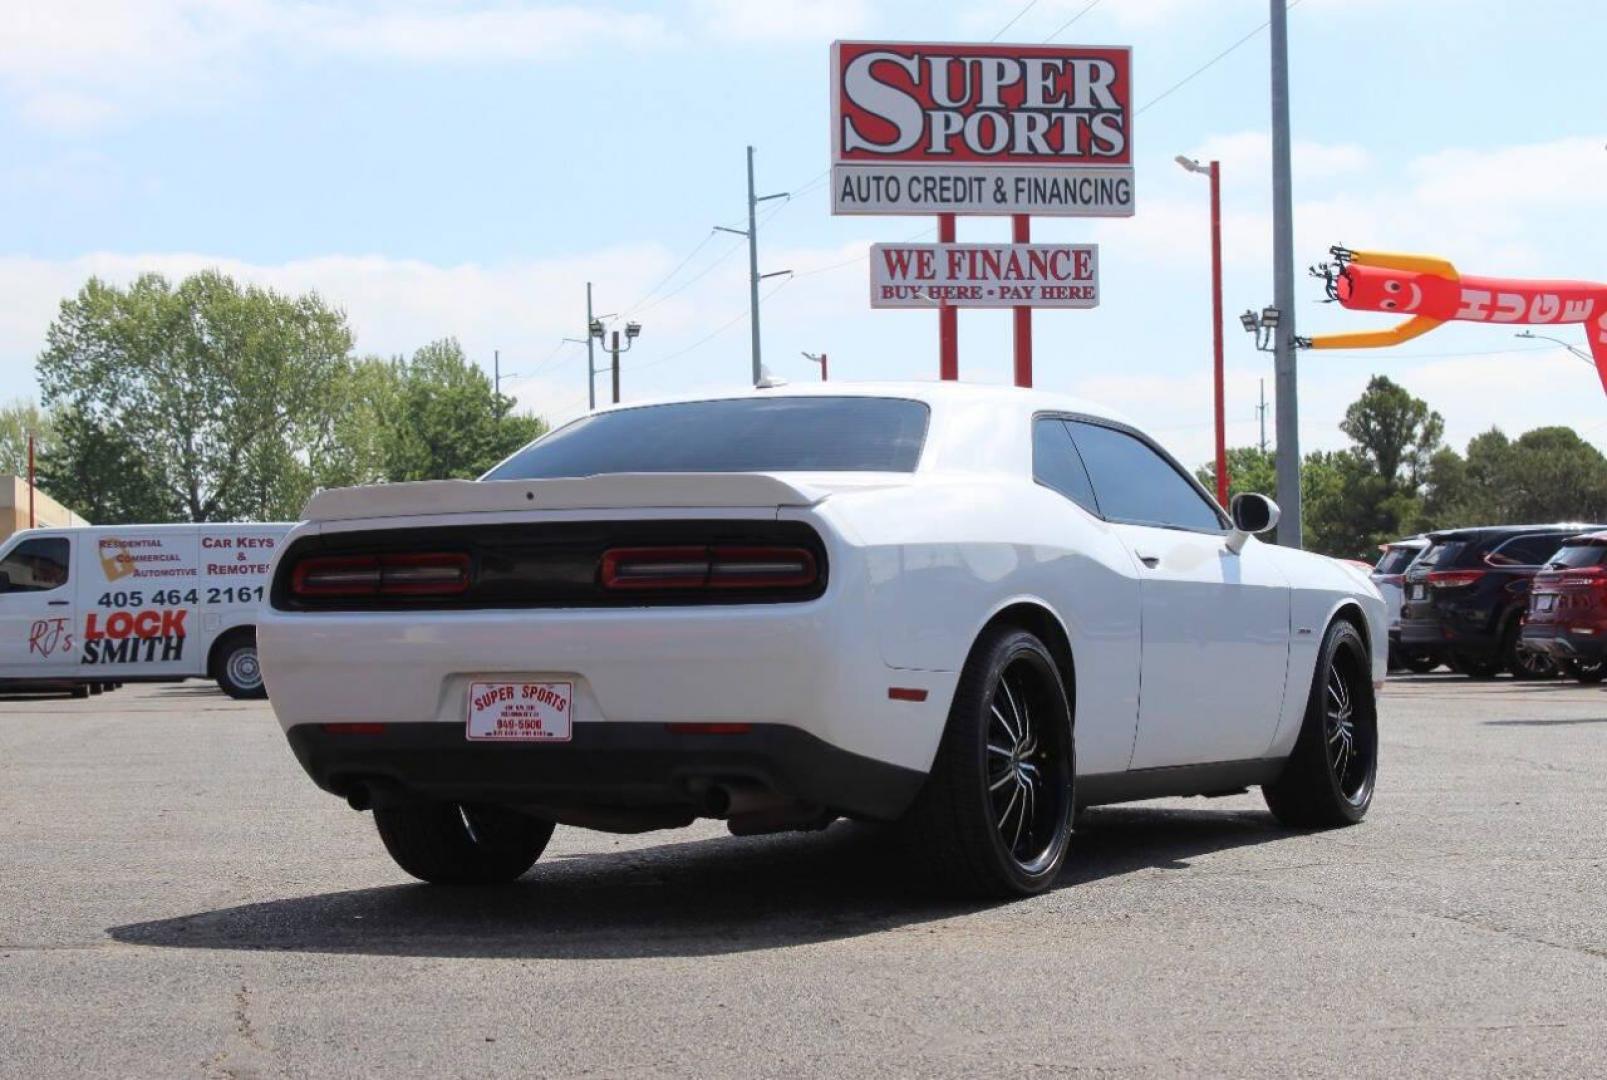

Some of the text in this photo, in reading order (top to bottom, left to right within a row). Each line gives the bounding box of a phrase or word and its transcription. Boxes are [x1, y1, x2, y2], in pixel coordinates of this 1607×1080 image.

[844, 51, 1122, 154] SUPER
[840, 175, 1131, 206] AUTO CREDIT & FINANCING
[881, 248, 1094, 281] WE FINANCE
[881, 285, 1096, 300] BUY HERE PAY HERE
[99, 539, 163, 548] RESIDENTIAL
[202, 537, 275, 548] CAR KEYS
[116, 554, 181, 563] COMMERCIAL
[236, 551, 247, 561] &
[132, 568, 198, 578] AUTOMOTIVE
[98, 586, 264, 608] 405 464 2161
[85, 610, 188, 640] LOCK
[80, 636, 185, 665] SMITH
[474, 684, 567, 712] SUPER SPORTS
